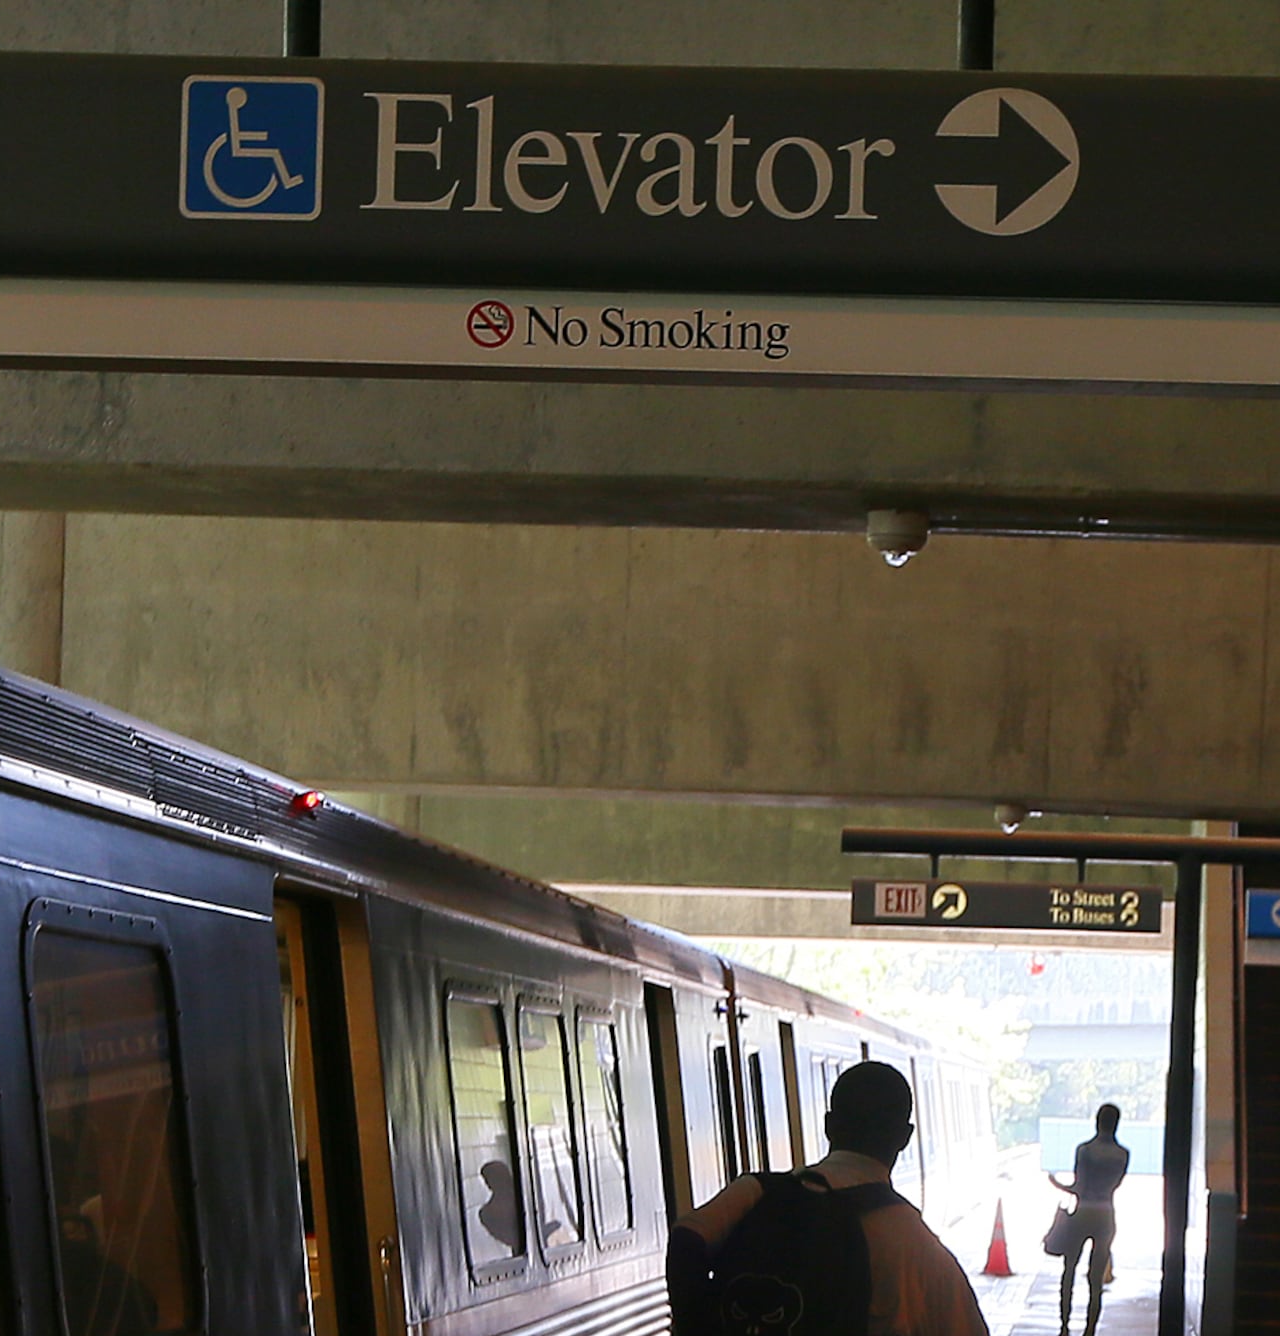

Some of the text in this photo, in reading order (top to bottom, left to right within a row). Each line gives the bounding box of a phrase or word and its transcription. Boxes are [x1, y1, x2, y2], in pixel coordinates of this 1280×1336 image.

[360, 92, 896, 219] Elevator
[524, 307, 791, 360] No Smoking
[885, 887, 919, 914] EXIT
[1050, 888, 1116, 908] To Street
[1050, 908, 1116, 926] To Buses
